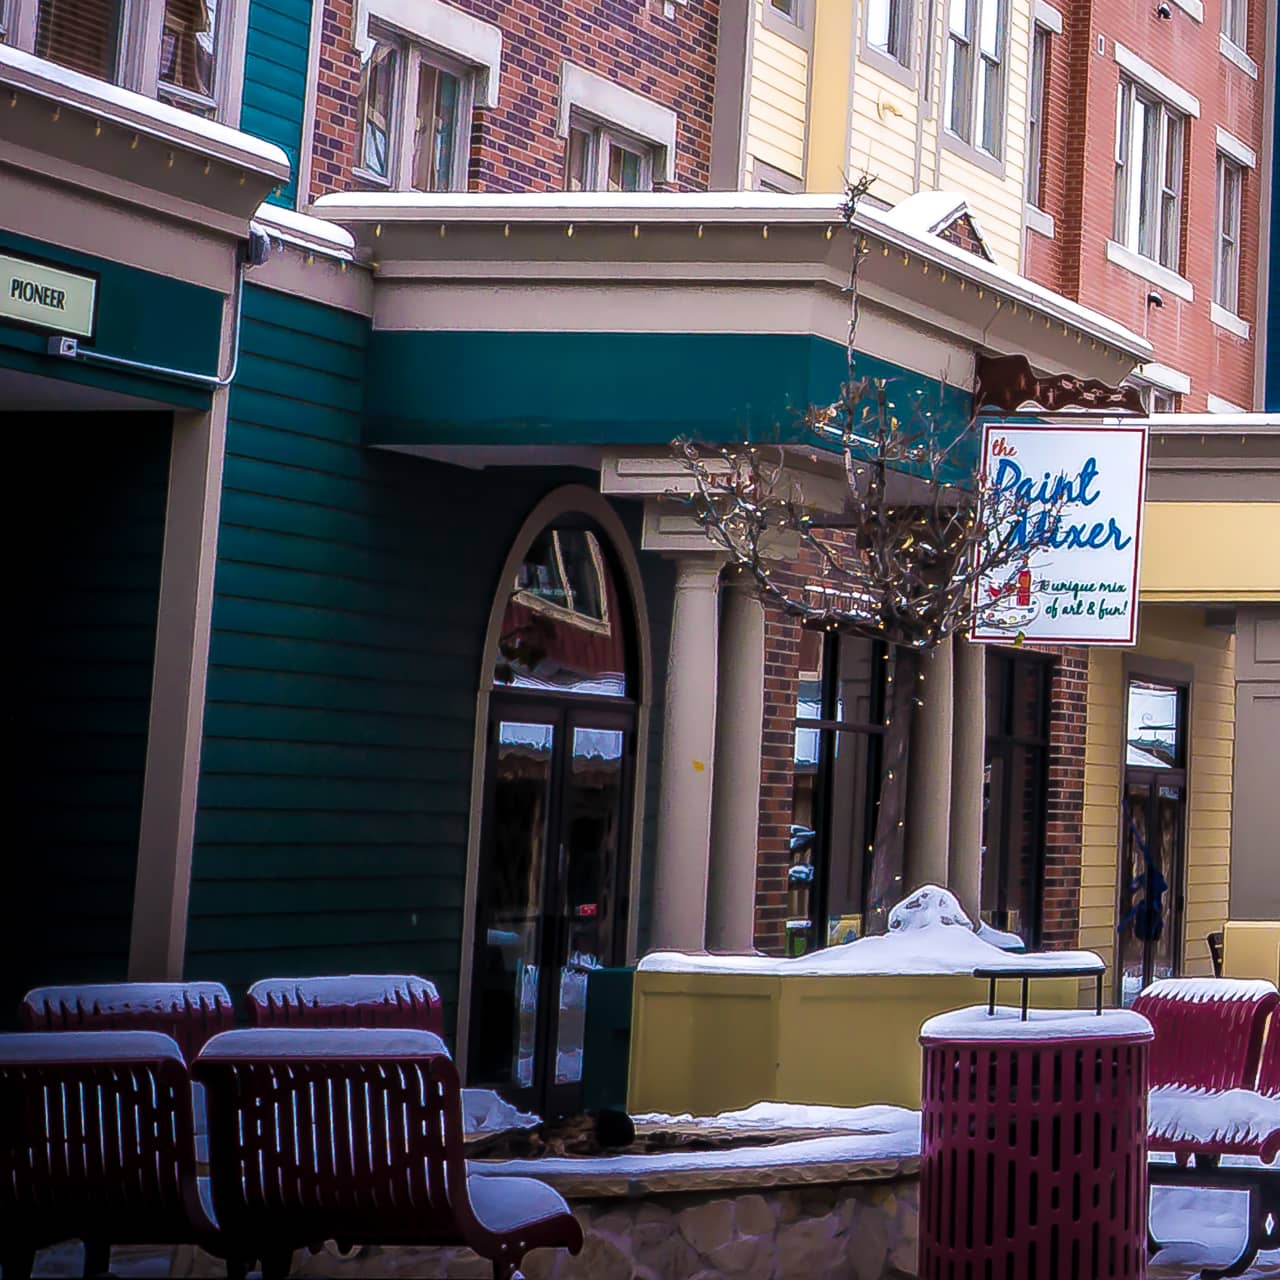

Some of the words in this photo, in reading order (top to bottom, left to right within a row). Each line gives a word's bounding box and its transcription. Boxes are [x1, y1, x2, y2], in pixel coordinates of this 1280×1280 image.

[10, 277, 66, 311] PIONEER
[991, 436, 1018, 457] the
[993, 457, 1101, 507] Paint
[1008, 506, 1132, 551] Mixer
[1051, 580, 1097, 600] unique
[1099, 581, 1127, 593] mix
[1045, 596, 1059, 619] of
[1061, 599, 1083, 616] art
[1086, 601, 1096, 616] &
[1098, 598, 1129, 620] fun!
